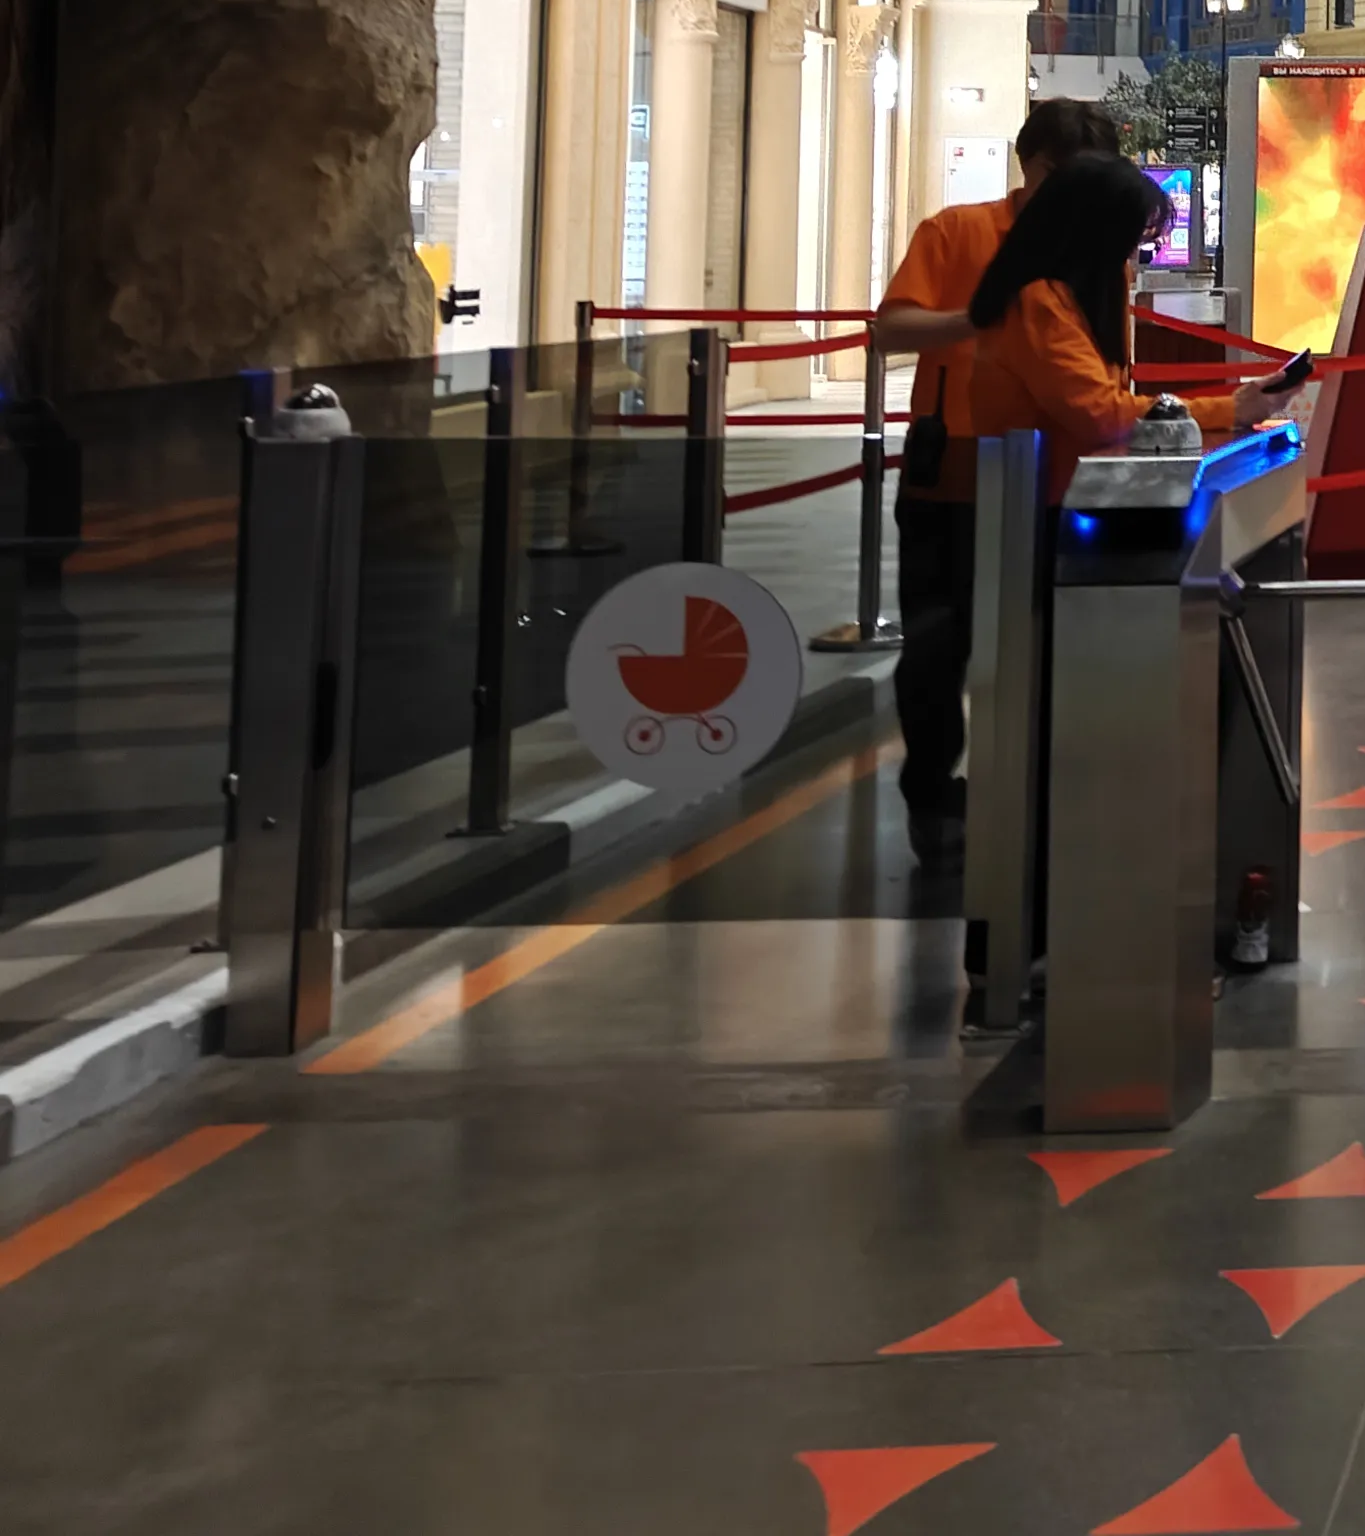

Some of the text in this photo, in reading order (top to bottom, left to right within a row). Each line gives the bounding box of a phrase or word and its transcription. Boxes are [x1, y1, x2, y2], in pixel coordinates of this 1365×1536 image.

[1273, 67, 1287, 75] ВЫ
[1289, 67, 1347, 76] НАХОДИТЕСЬ
[1349, 67, 1355, 75] В
